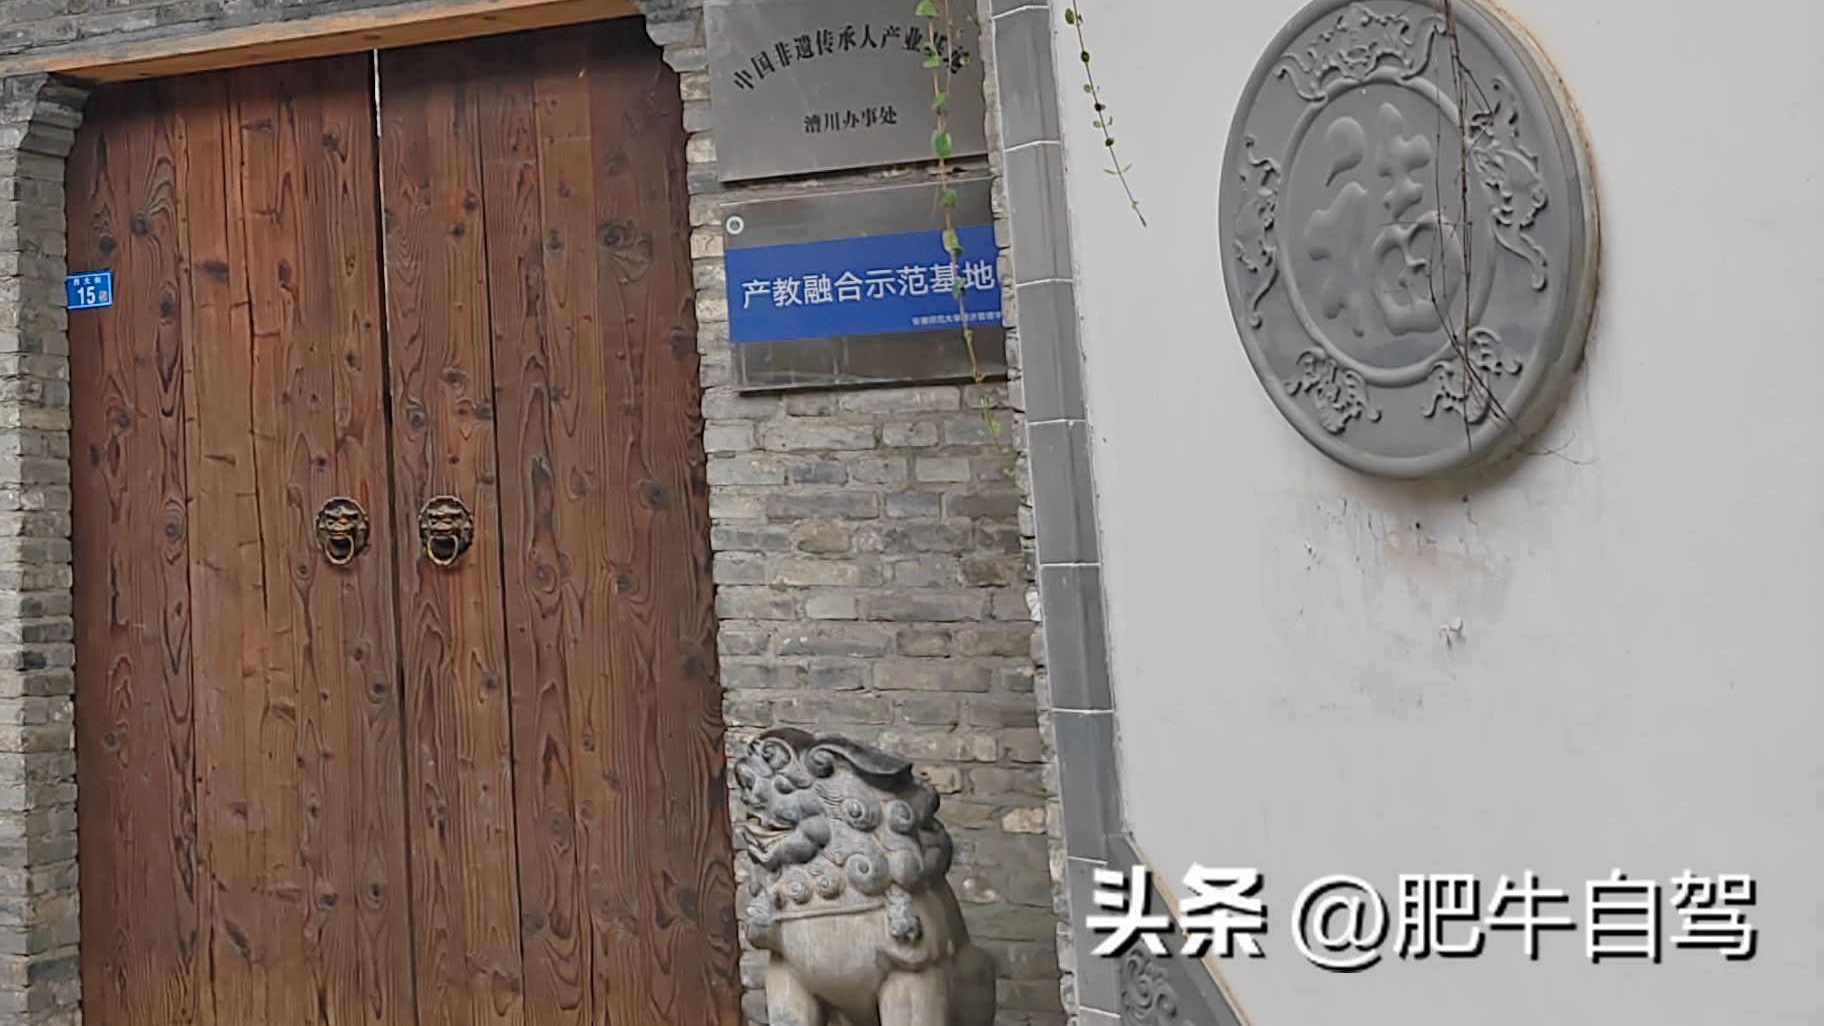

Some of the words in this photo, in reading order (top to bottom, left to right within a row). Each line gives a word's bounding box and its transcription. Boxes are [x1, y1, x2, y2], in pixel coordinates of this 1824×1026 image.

[803, 105, 899, 134] 漕川办事处
[77, 286, 96, 306] 15
[741, 260, 996, 310] 产教融合示范基地
